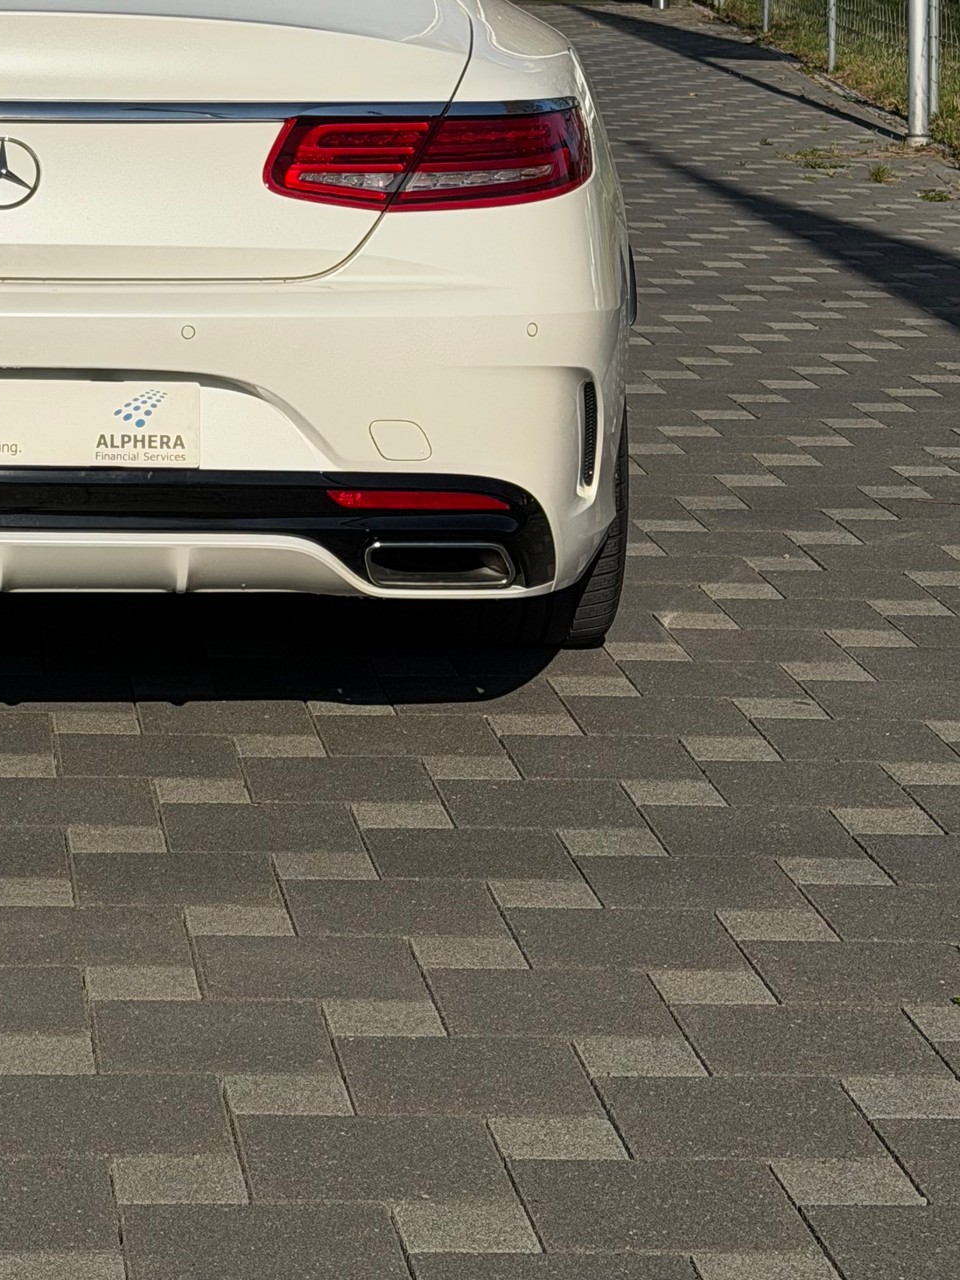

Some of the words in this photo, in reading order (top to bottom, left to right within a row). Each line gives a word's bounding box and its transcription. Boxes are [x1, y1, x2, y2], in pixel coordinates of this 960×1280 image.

[95, 433, 186, 450] ALPHERA
[95, 451, 140, 462] Financial
[143, 452, 186, 462] Services
